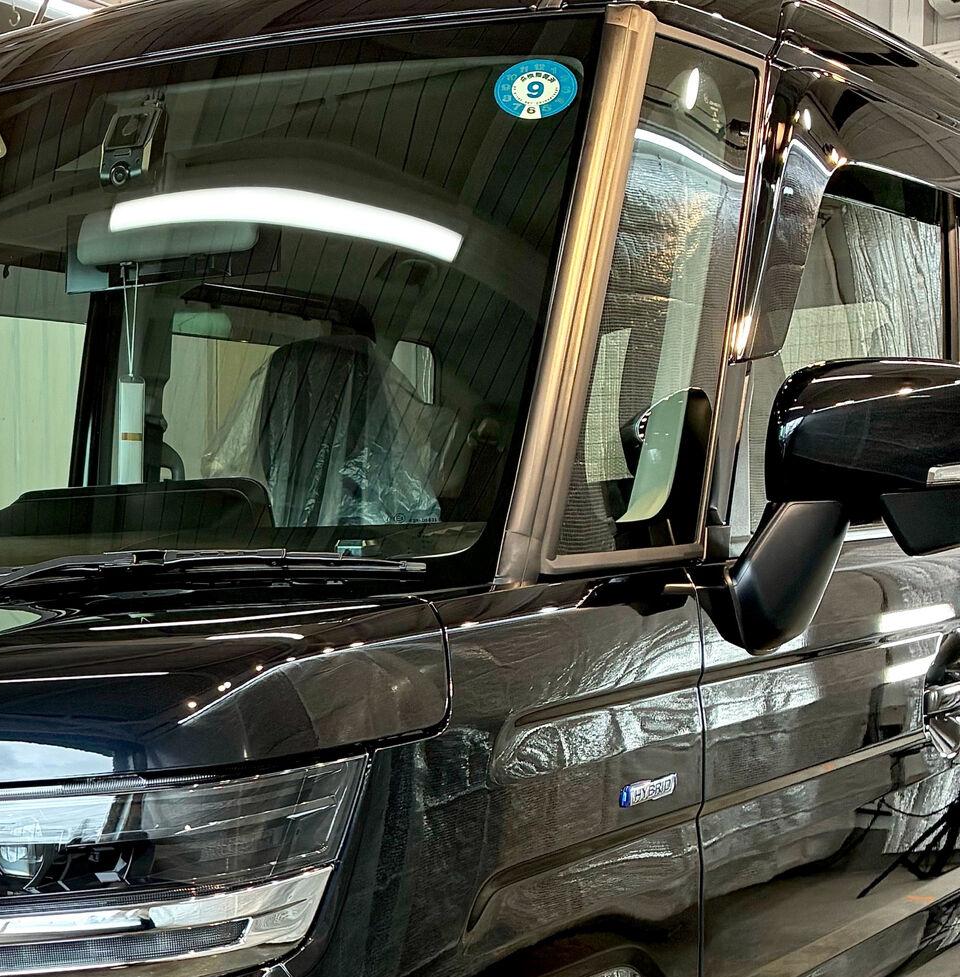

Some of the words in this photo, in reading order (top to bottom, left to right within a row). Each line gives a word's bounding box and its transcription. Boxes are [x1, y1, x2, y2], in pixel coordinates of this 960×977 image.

[526, 81, 544, 98] 9
[526, 106, 536, 114] 6
[634, 779, 672, 802] HYBRID
